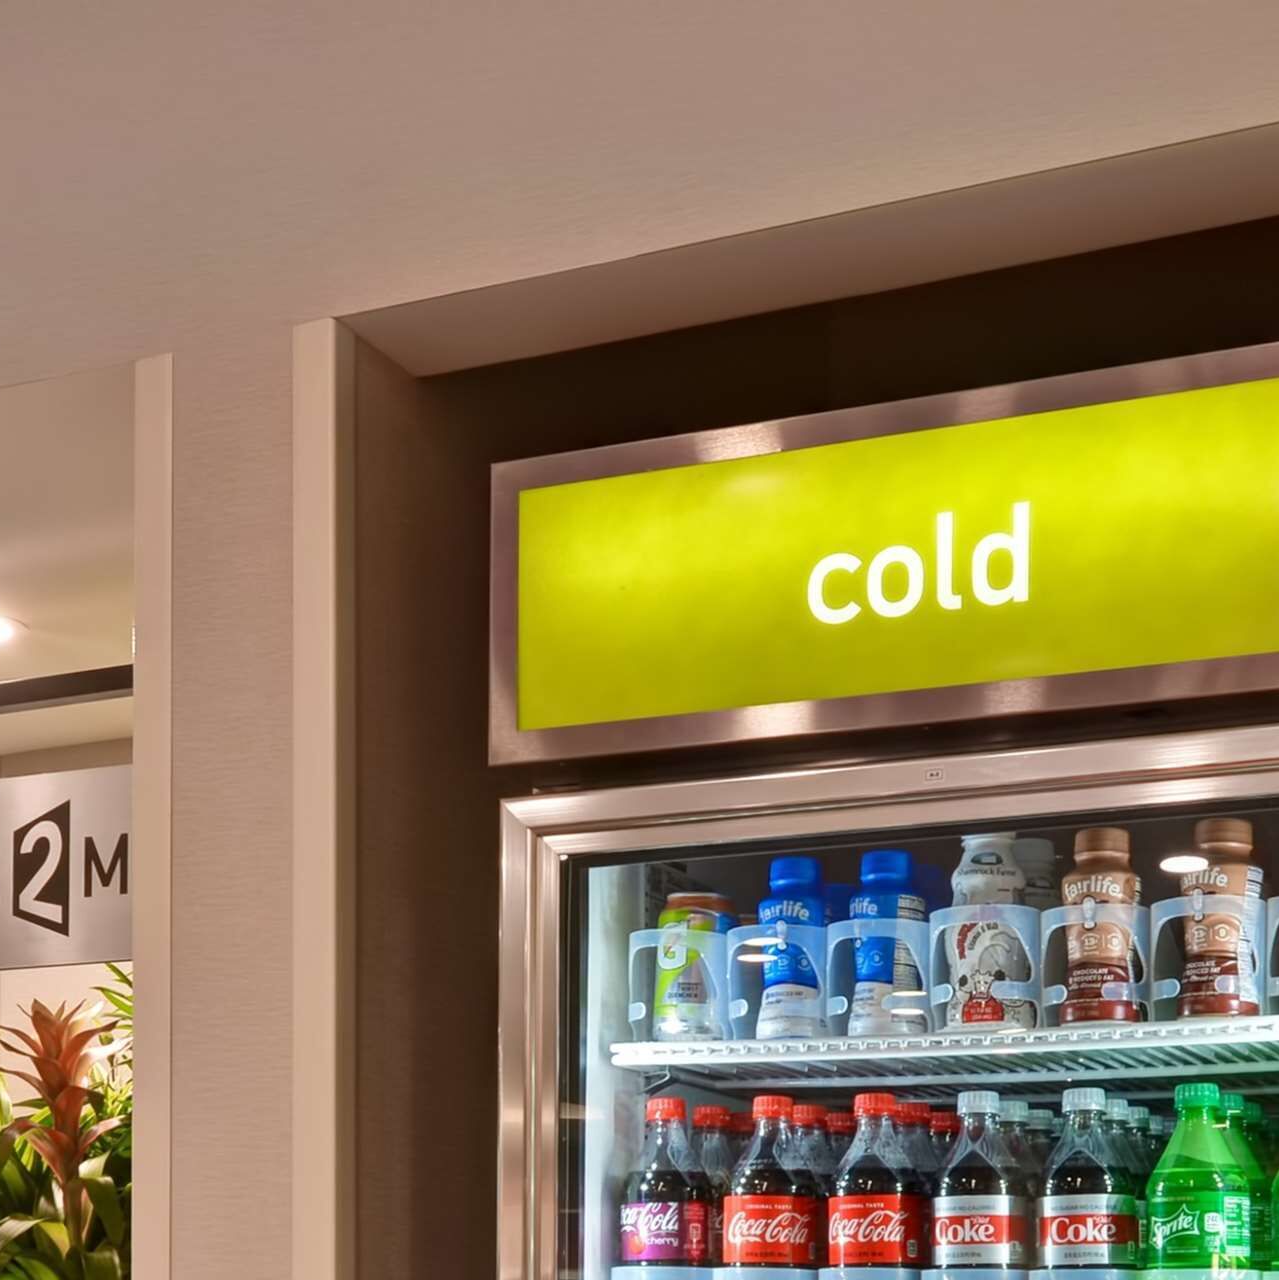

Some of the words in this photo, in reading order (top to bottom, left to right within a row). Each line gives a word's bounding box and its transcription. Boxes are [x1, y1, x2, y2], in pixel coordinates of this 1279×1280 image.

[806, 500, 1031, 625] cold
[728, 1210, 809, 1244] Coca-Cola
[829, 1210, 907, 1244] Coca-Cola
[935, 1217, 995, 1246] Coke
[1050, 1214, 1117, 1244] Coke
